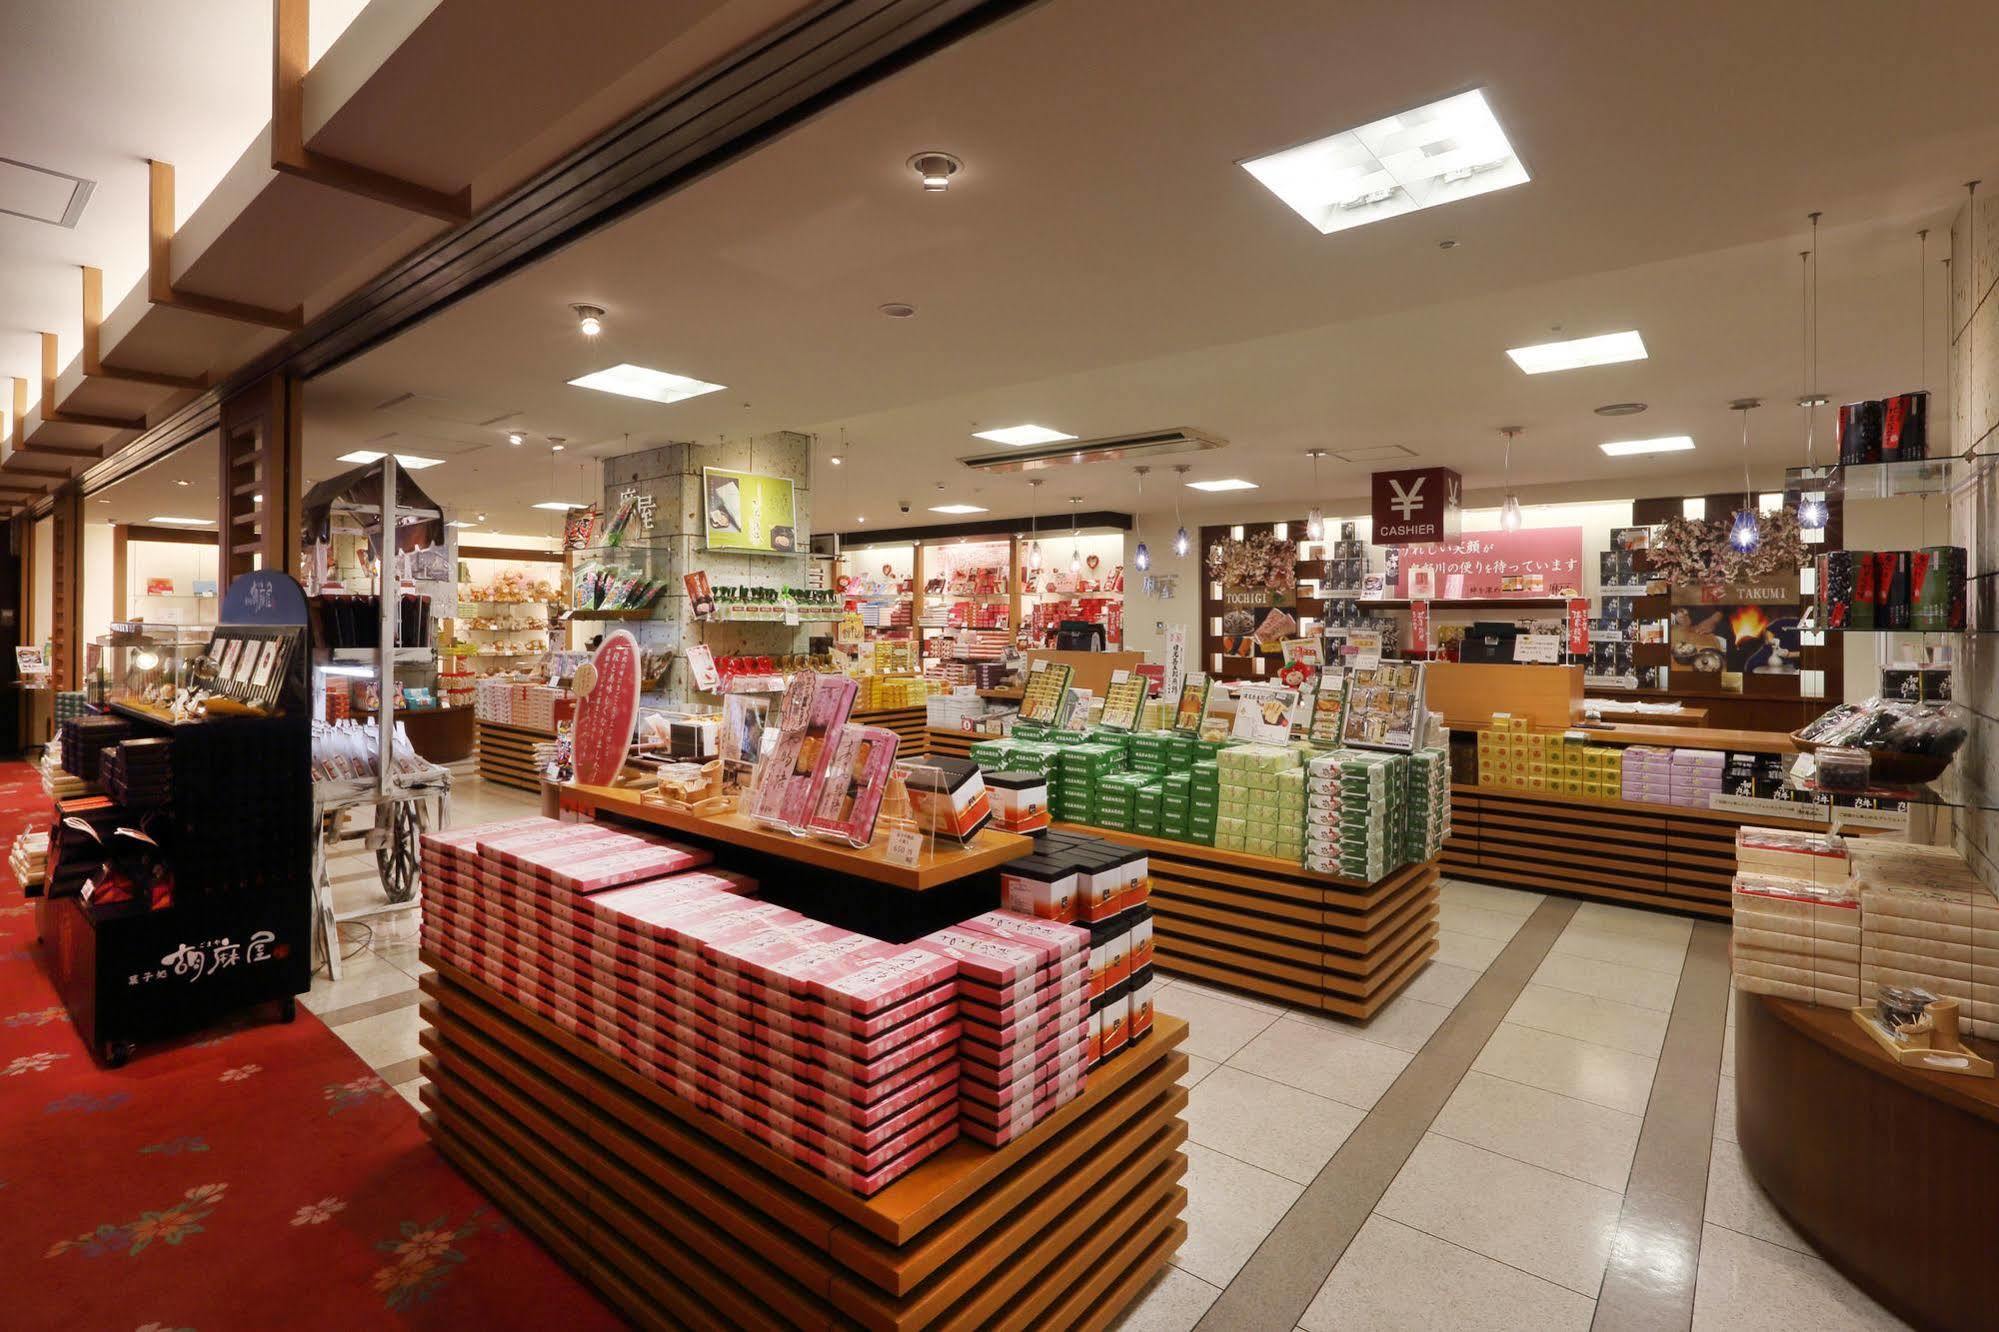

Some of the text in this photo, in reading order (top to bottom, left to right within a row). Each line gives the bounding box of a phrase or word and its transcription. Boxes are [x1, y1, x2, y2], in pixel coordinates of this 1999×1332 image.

[1380, 524, 1435, 536] CASHIER
[1226, 593, 1268, 604] TOCHIGI
[1736, 587, 1786, 599] TAKUMI
